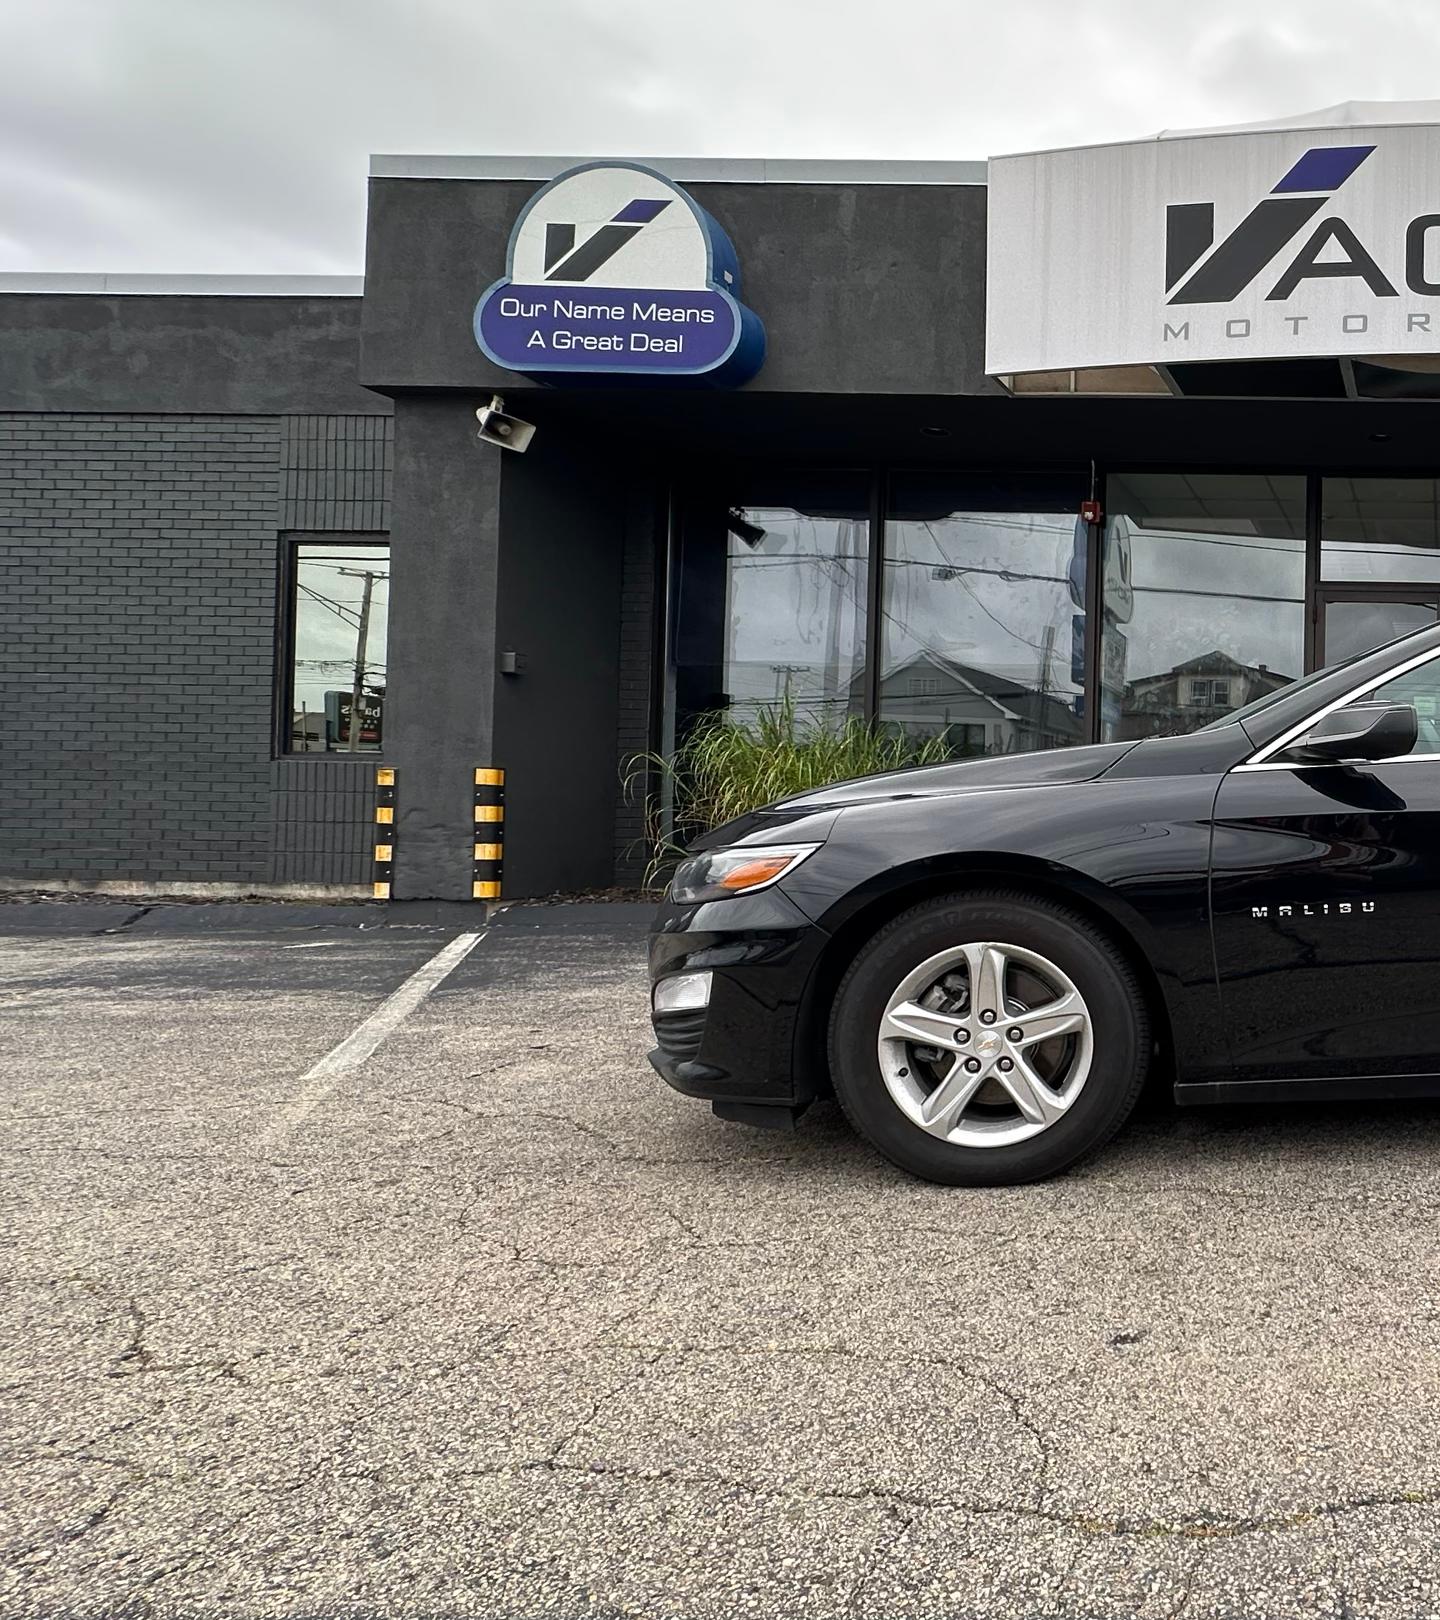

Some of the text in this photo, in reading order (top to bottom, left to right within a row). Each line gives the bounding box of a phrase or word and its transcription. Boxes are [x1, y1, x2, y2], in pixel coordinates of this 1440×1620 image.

[499, 297, 715, 323] Our Name Means
[1162, 312, 1432, 342] MOTOR
[526, 330, 683, 353] A Great Deal
[1251, 901, 1375, 918] MALIBU
